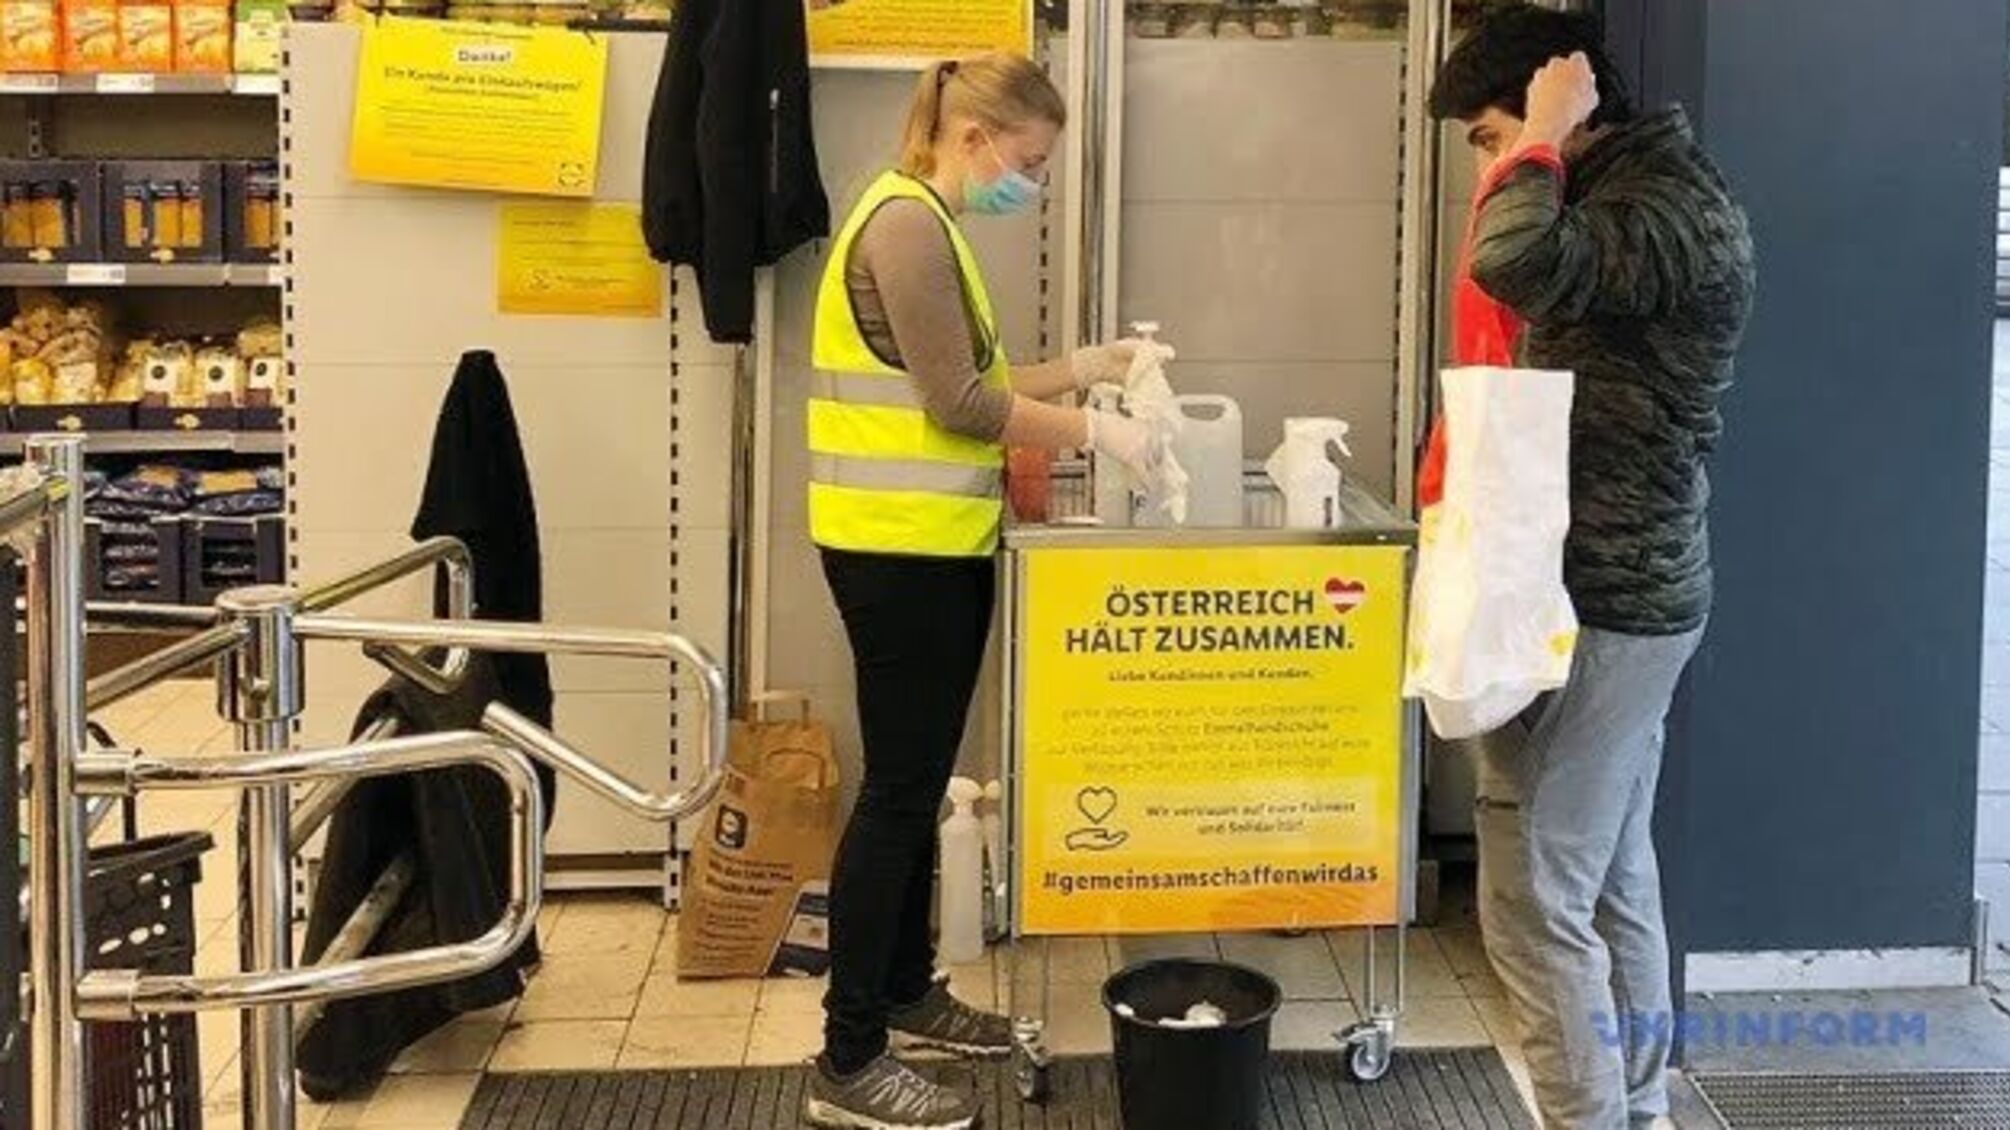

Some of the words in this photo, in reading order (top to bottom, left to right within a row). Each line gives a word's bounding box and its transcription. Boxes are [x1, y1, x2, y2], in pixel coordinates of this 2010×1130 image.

[1106, 585, 1314, 617] ÖSTERREICH
[1066, 620, 1147, 652] HÄLT
[1155, 625, 1354, 652] ZUSAMMEN.
[1043, 863, 1378, 894] #gemeinsamschaffenwirdas
